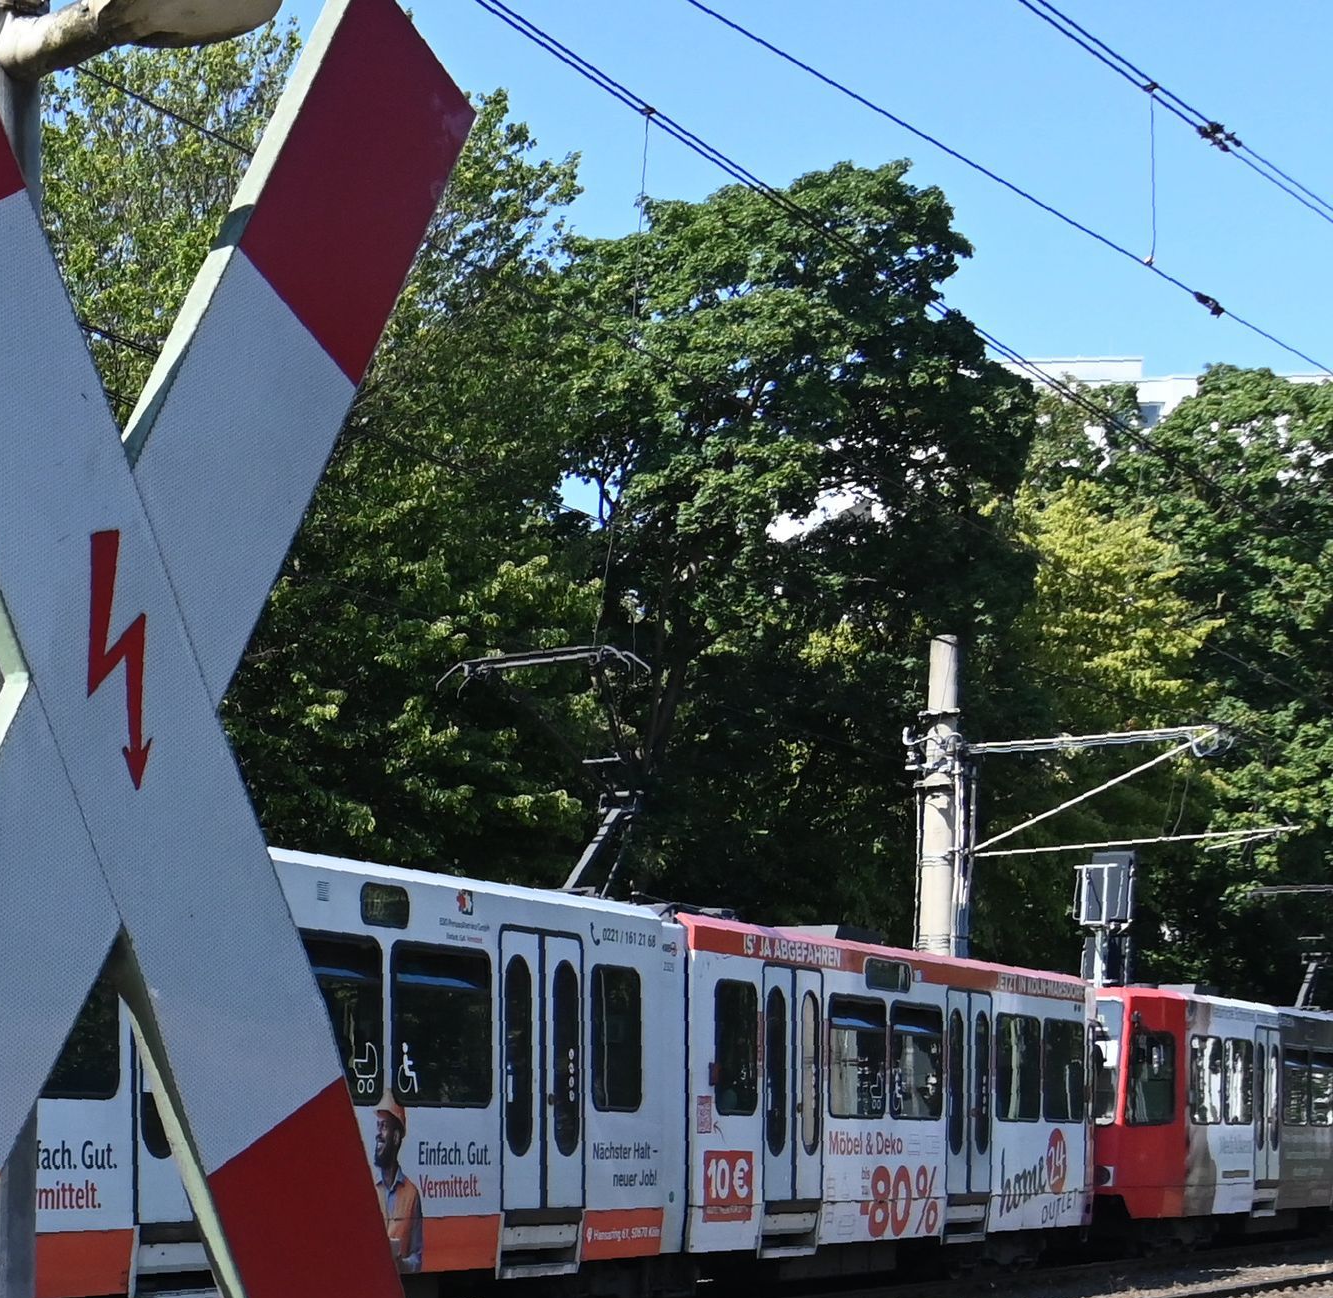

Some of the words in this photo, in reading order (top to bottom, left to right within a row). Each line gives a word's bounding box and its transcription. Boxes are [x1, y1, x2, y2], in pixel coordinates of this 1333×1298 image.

[743, 934, 756, 955] IS'
[758, 937, 772, 957] JA
[773, 939, 841, 967] ABGEFAHREN
[81, 1140, 118, 1170] Gut.
[418, 1141, 464, 1166] Einfach.
[467, 1141, 491, 1166] Gut.
[593, 1141, 632, 1160] Nächster
[633, 1141, 651, 1160] Halt
[829, 1130, 863, 1156] Möbel
[865, 1132, 874, 1156] &
[876, 1131, 903, 1156] Deko
[419, 1173, 481, 1199] Vermittelt.
[613, 1172, 637, 1187] neuer
[639, 1169, 658, 1187] Job!
[707, 1158, 730, 1199] 10
[733, 1158, 749, 1199] €
[1041, 1188, 1079, 1225] OUTLET
